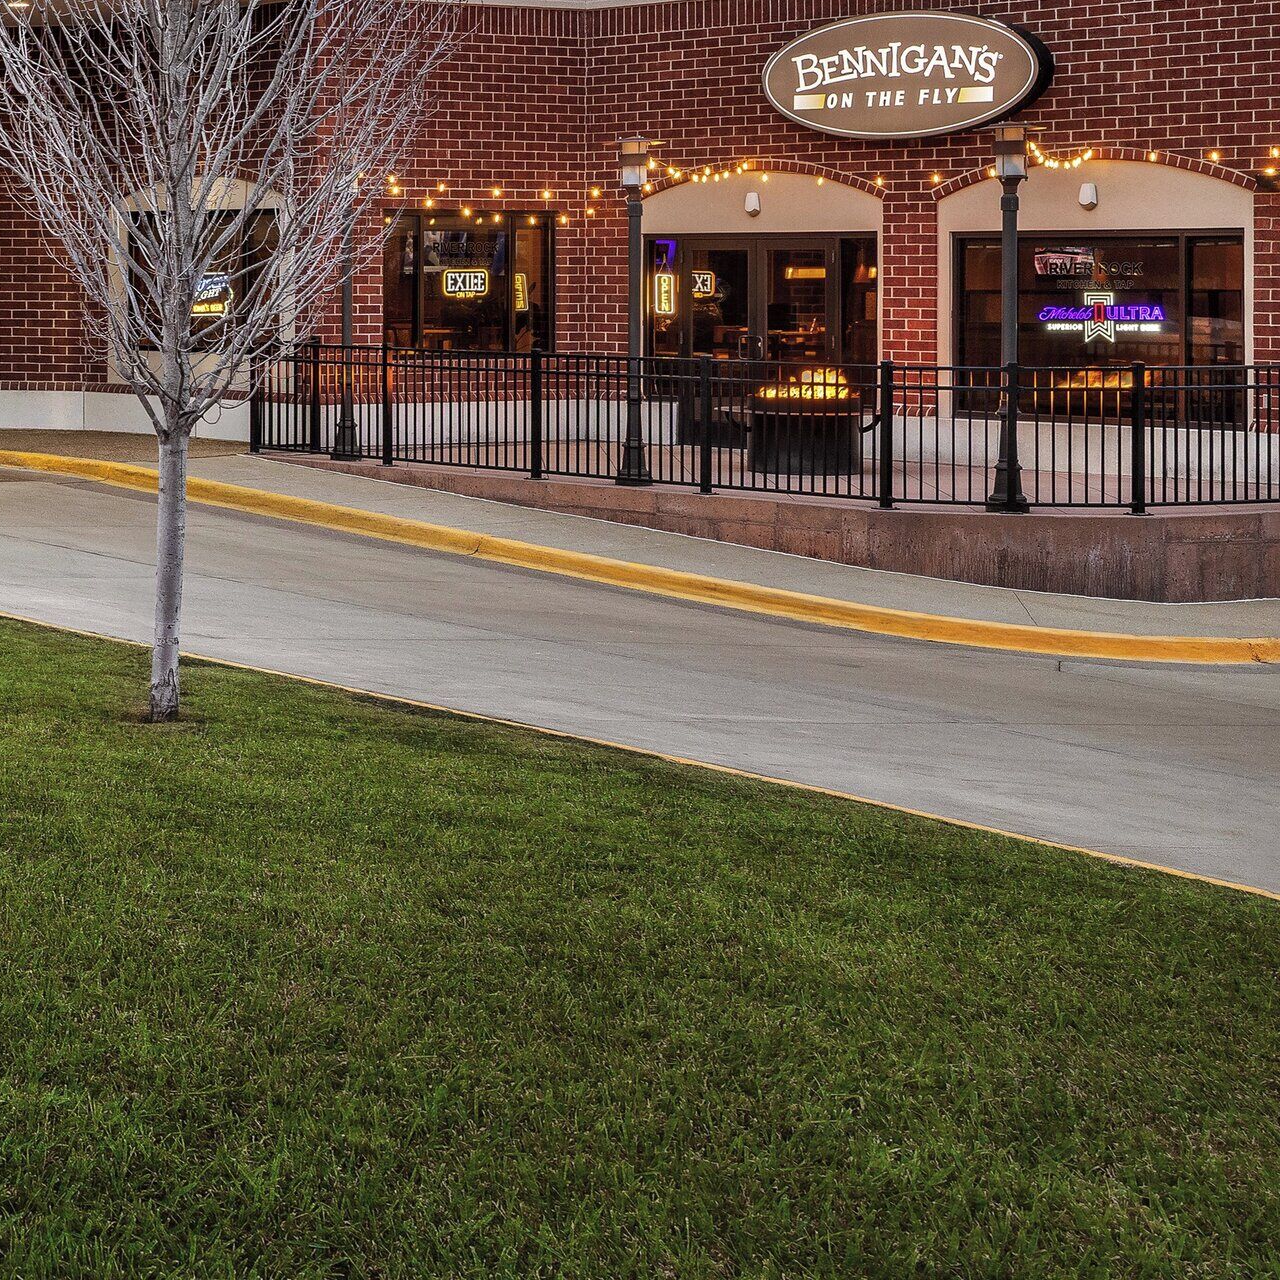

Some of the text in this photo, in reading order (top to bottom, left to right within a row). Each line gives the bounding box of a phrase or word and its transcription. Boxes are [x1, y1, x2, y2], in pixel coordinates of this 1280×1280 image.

[791, 42, 1000, 93] BENNIGAN'S
[826, 87, 959, 109] ON THE FLY
[433, 242, 499, 254] RIVER ROCK
[1048, 261, 1144, 275] RIVER ROCK
[447, 272, 485, 291] EXILE
[1057, 280, 1135, 289] KITCHEN & TAP
[661, 276, 669, 312] OPEN
[1040, 306, 1163, 320] Michelob ULTRA
[1047, 323, 1083, 331] SUPERIOR
[1115, 323, 1138, 331] LIGHT
